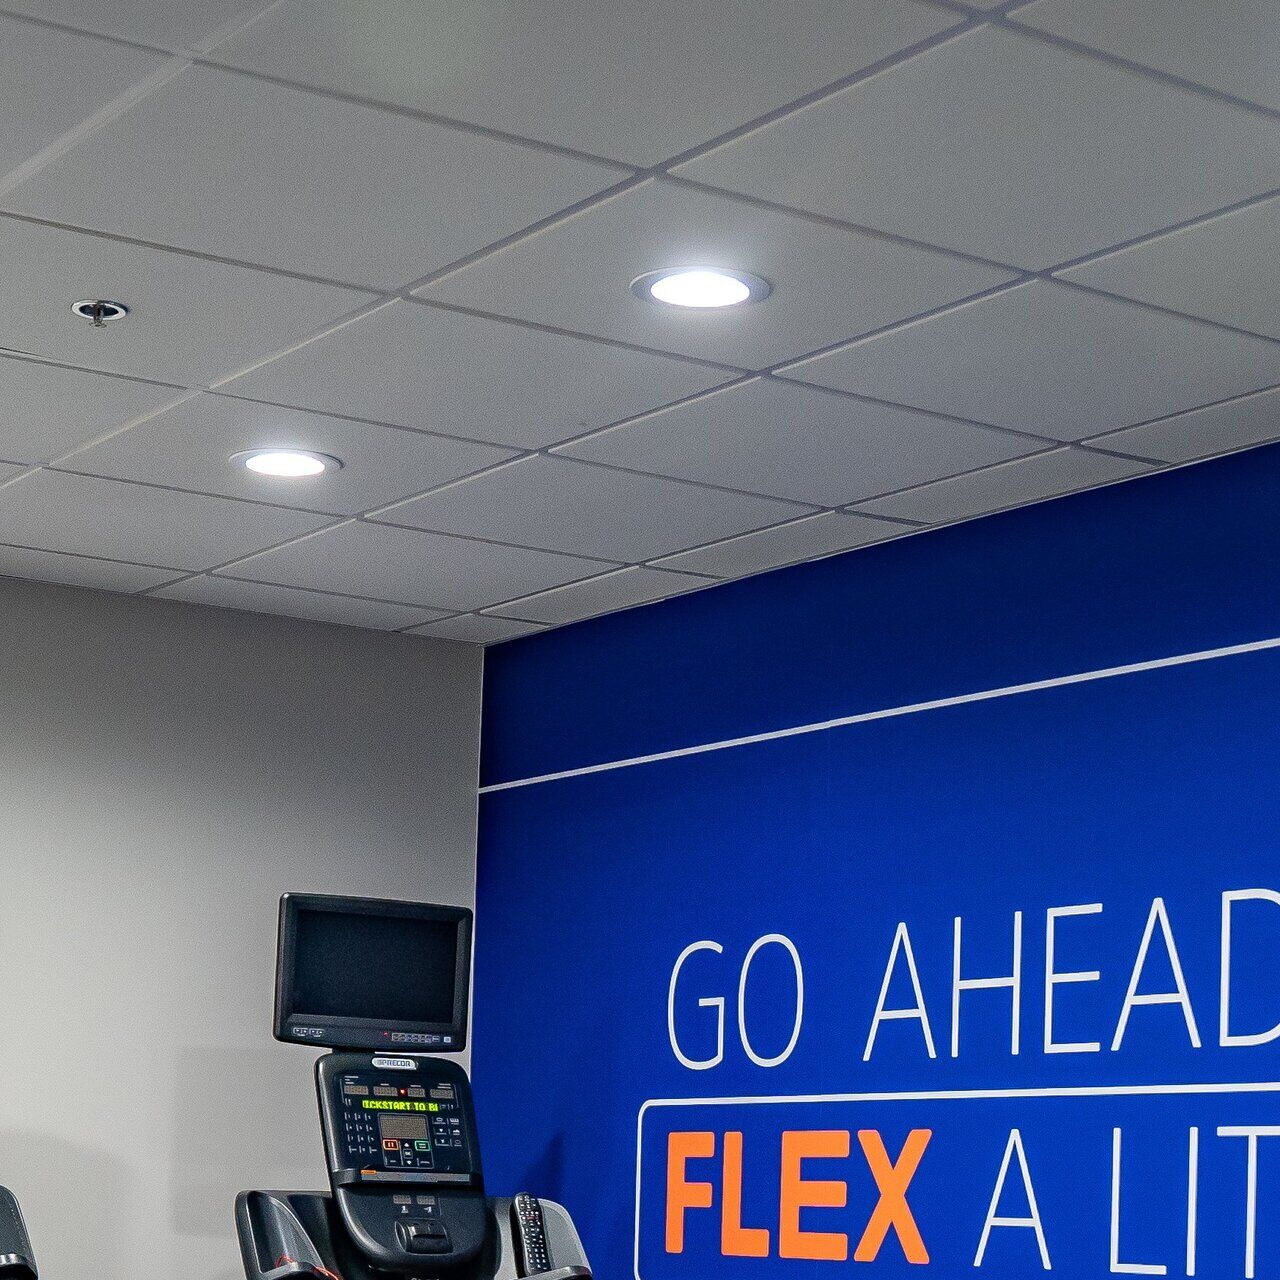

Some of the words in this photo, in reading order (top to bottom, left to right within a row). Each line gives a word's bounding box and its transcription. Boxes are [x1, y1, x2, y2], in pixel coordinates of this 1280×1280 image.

[667, 933, 804, 1071] GO
[665, 1128, 933, 1265] FLEX
[973, 1128, 1052, 1271] A
